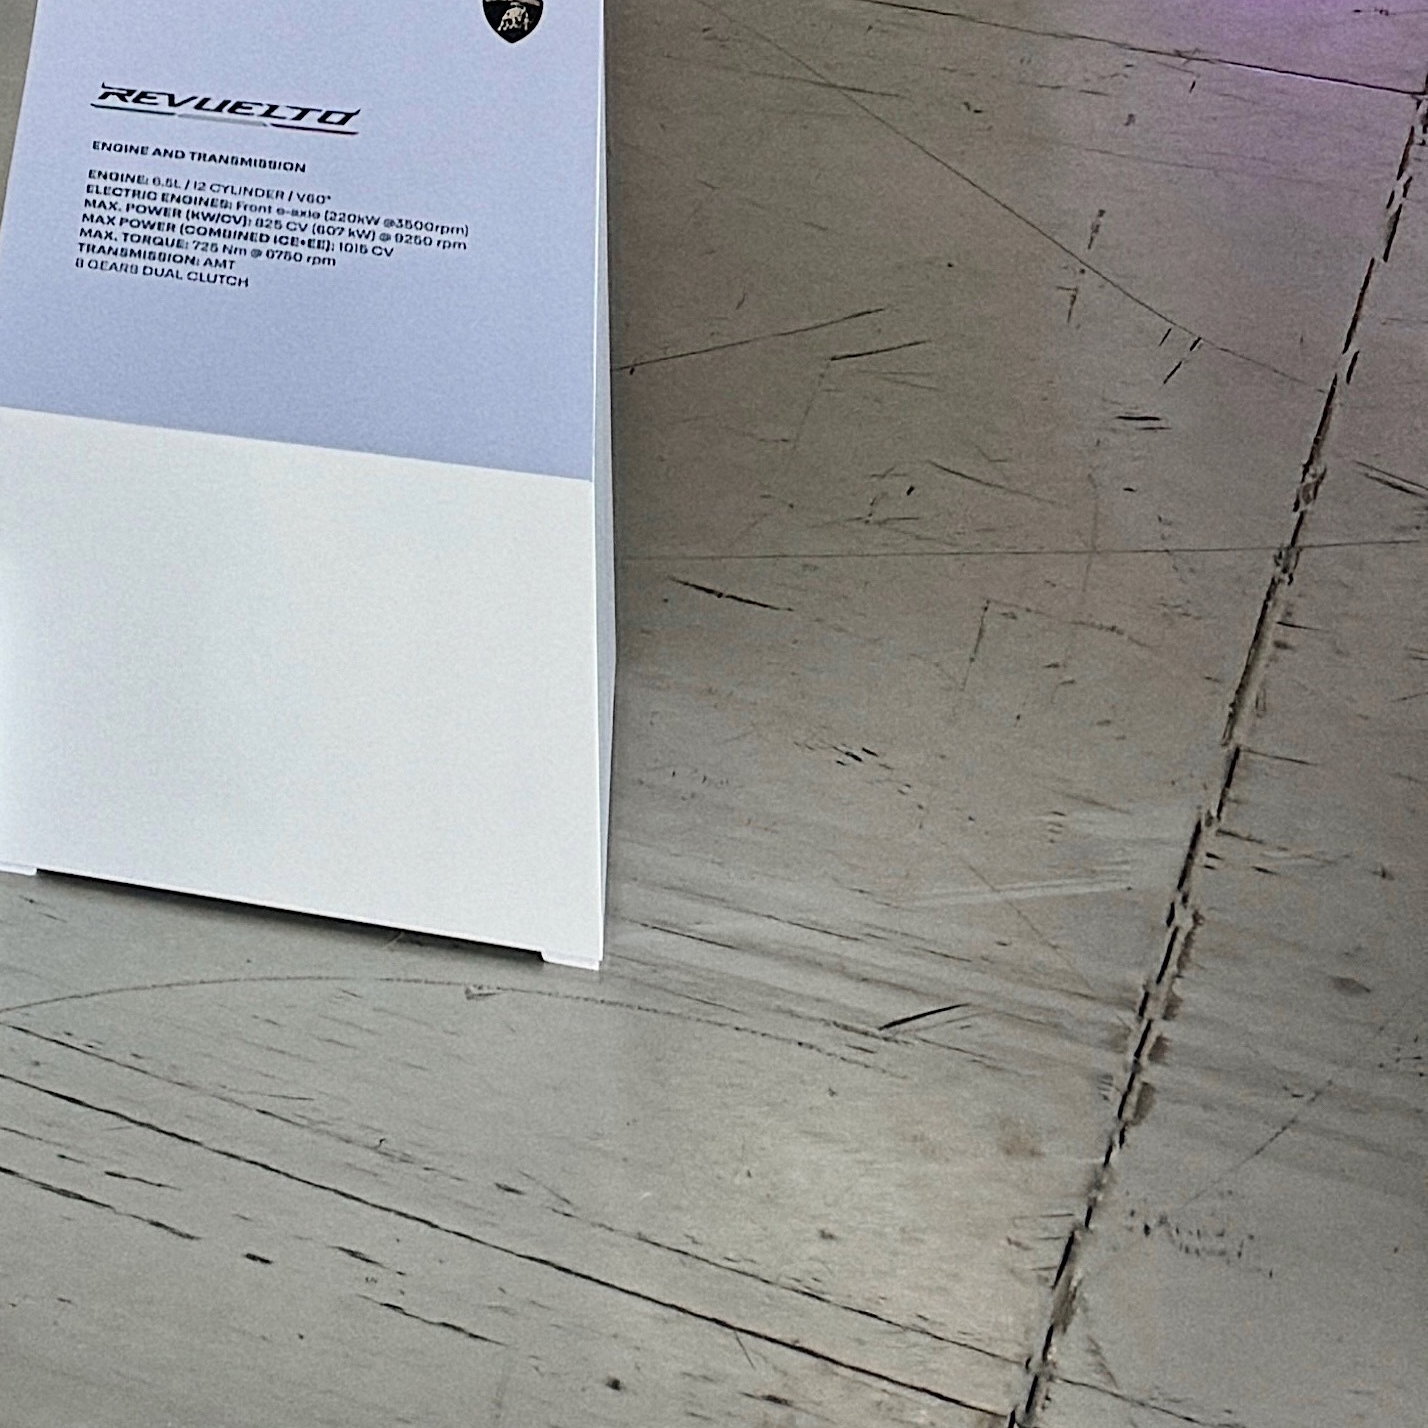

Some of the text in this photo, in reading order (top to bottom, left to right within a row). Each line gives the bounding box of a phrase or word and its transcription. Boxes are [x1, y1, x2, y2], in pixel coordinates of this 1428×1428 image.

[98, 82, 362, 126] REVUELTO
[92, 140, 306, 173] ENGINE AND TRANSMISSION
[86, 184, 157, 201] ELECTRIC
[236, 200, 272, 215] Front
[209, 183, 285, 200] CYLINDER
[81, 213, 116, 227] MAX
[119, 216, 176, 233] POWER
[179, 222, 271, 243] (COMBINED
[371, 245, 394, 257] CV
[84, 198, 122, 212] MAX.
[125, 202, 182, 219] POWER
[286, 221, 308, 233] CV
[348, 227, 376, 242] kW)
[436, 238, 467, 251] rpm
[79, 227, 118, 242] MAX.
[222, 243, 247, 257] Nm
[306, 255, 336, 267] rpm
[203, 257, 236, 270] AMT
[87, 258, 139, 275] GEARS
[142, 265, 183, 281] DUAL
[186, 270, 249, 288] CLUTCH
